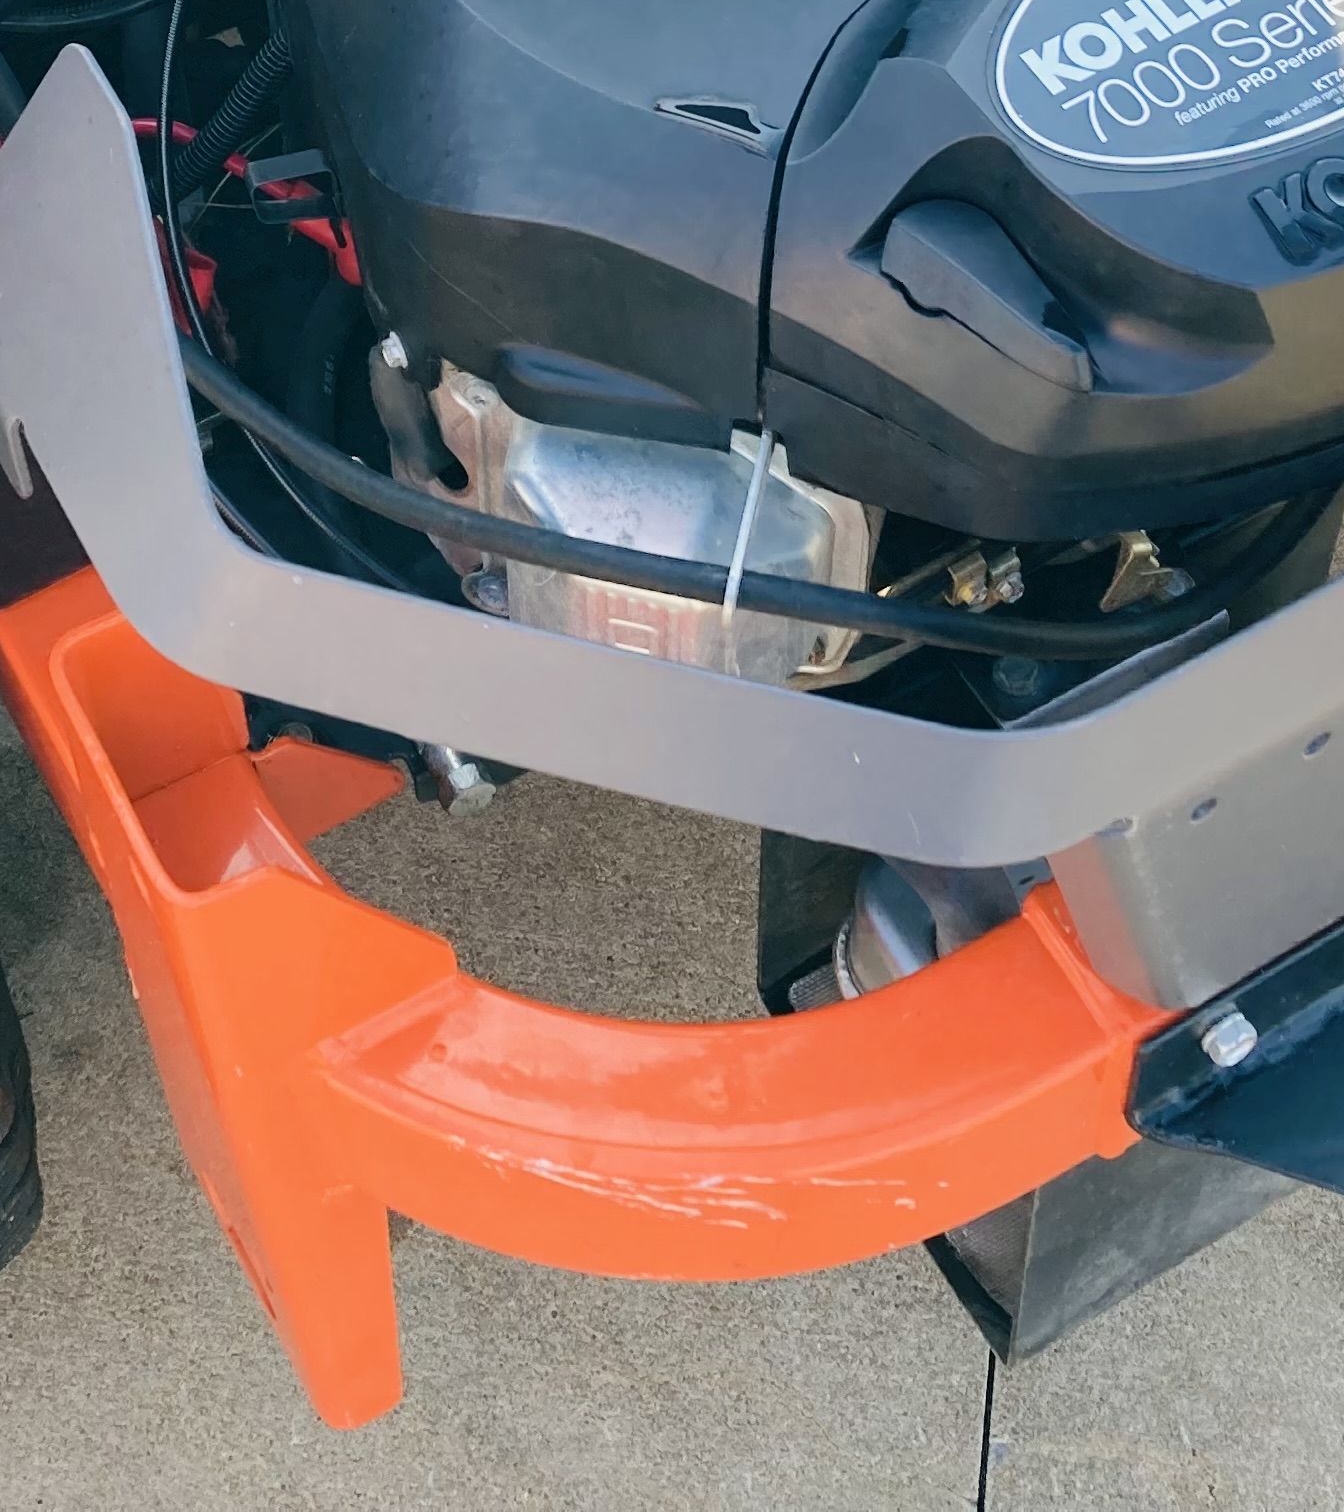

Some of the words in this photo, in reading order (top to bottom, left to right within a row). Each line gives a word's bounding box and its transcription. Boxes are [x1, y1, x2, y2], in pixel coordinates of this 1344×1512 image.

[1061, 43, 1221, 143] 7000
[1174, 86, 1241, 126] featuring
[1236, 66, 1278, 95] PRO
